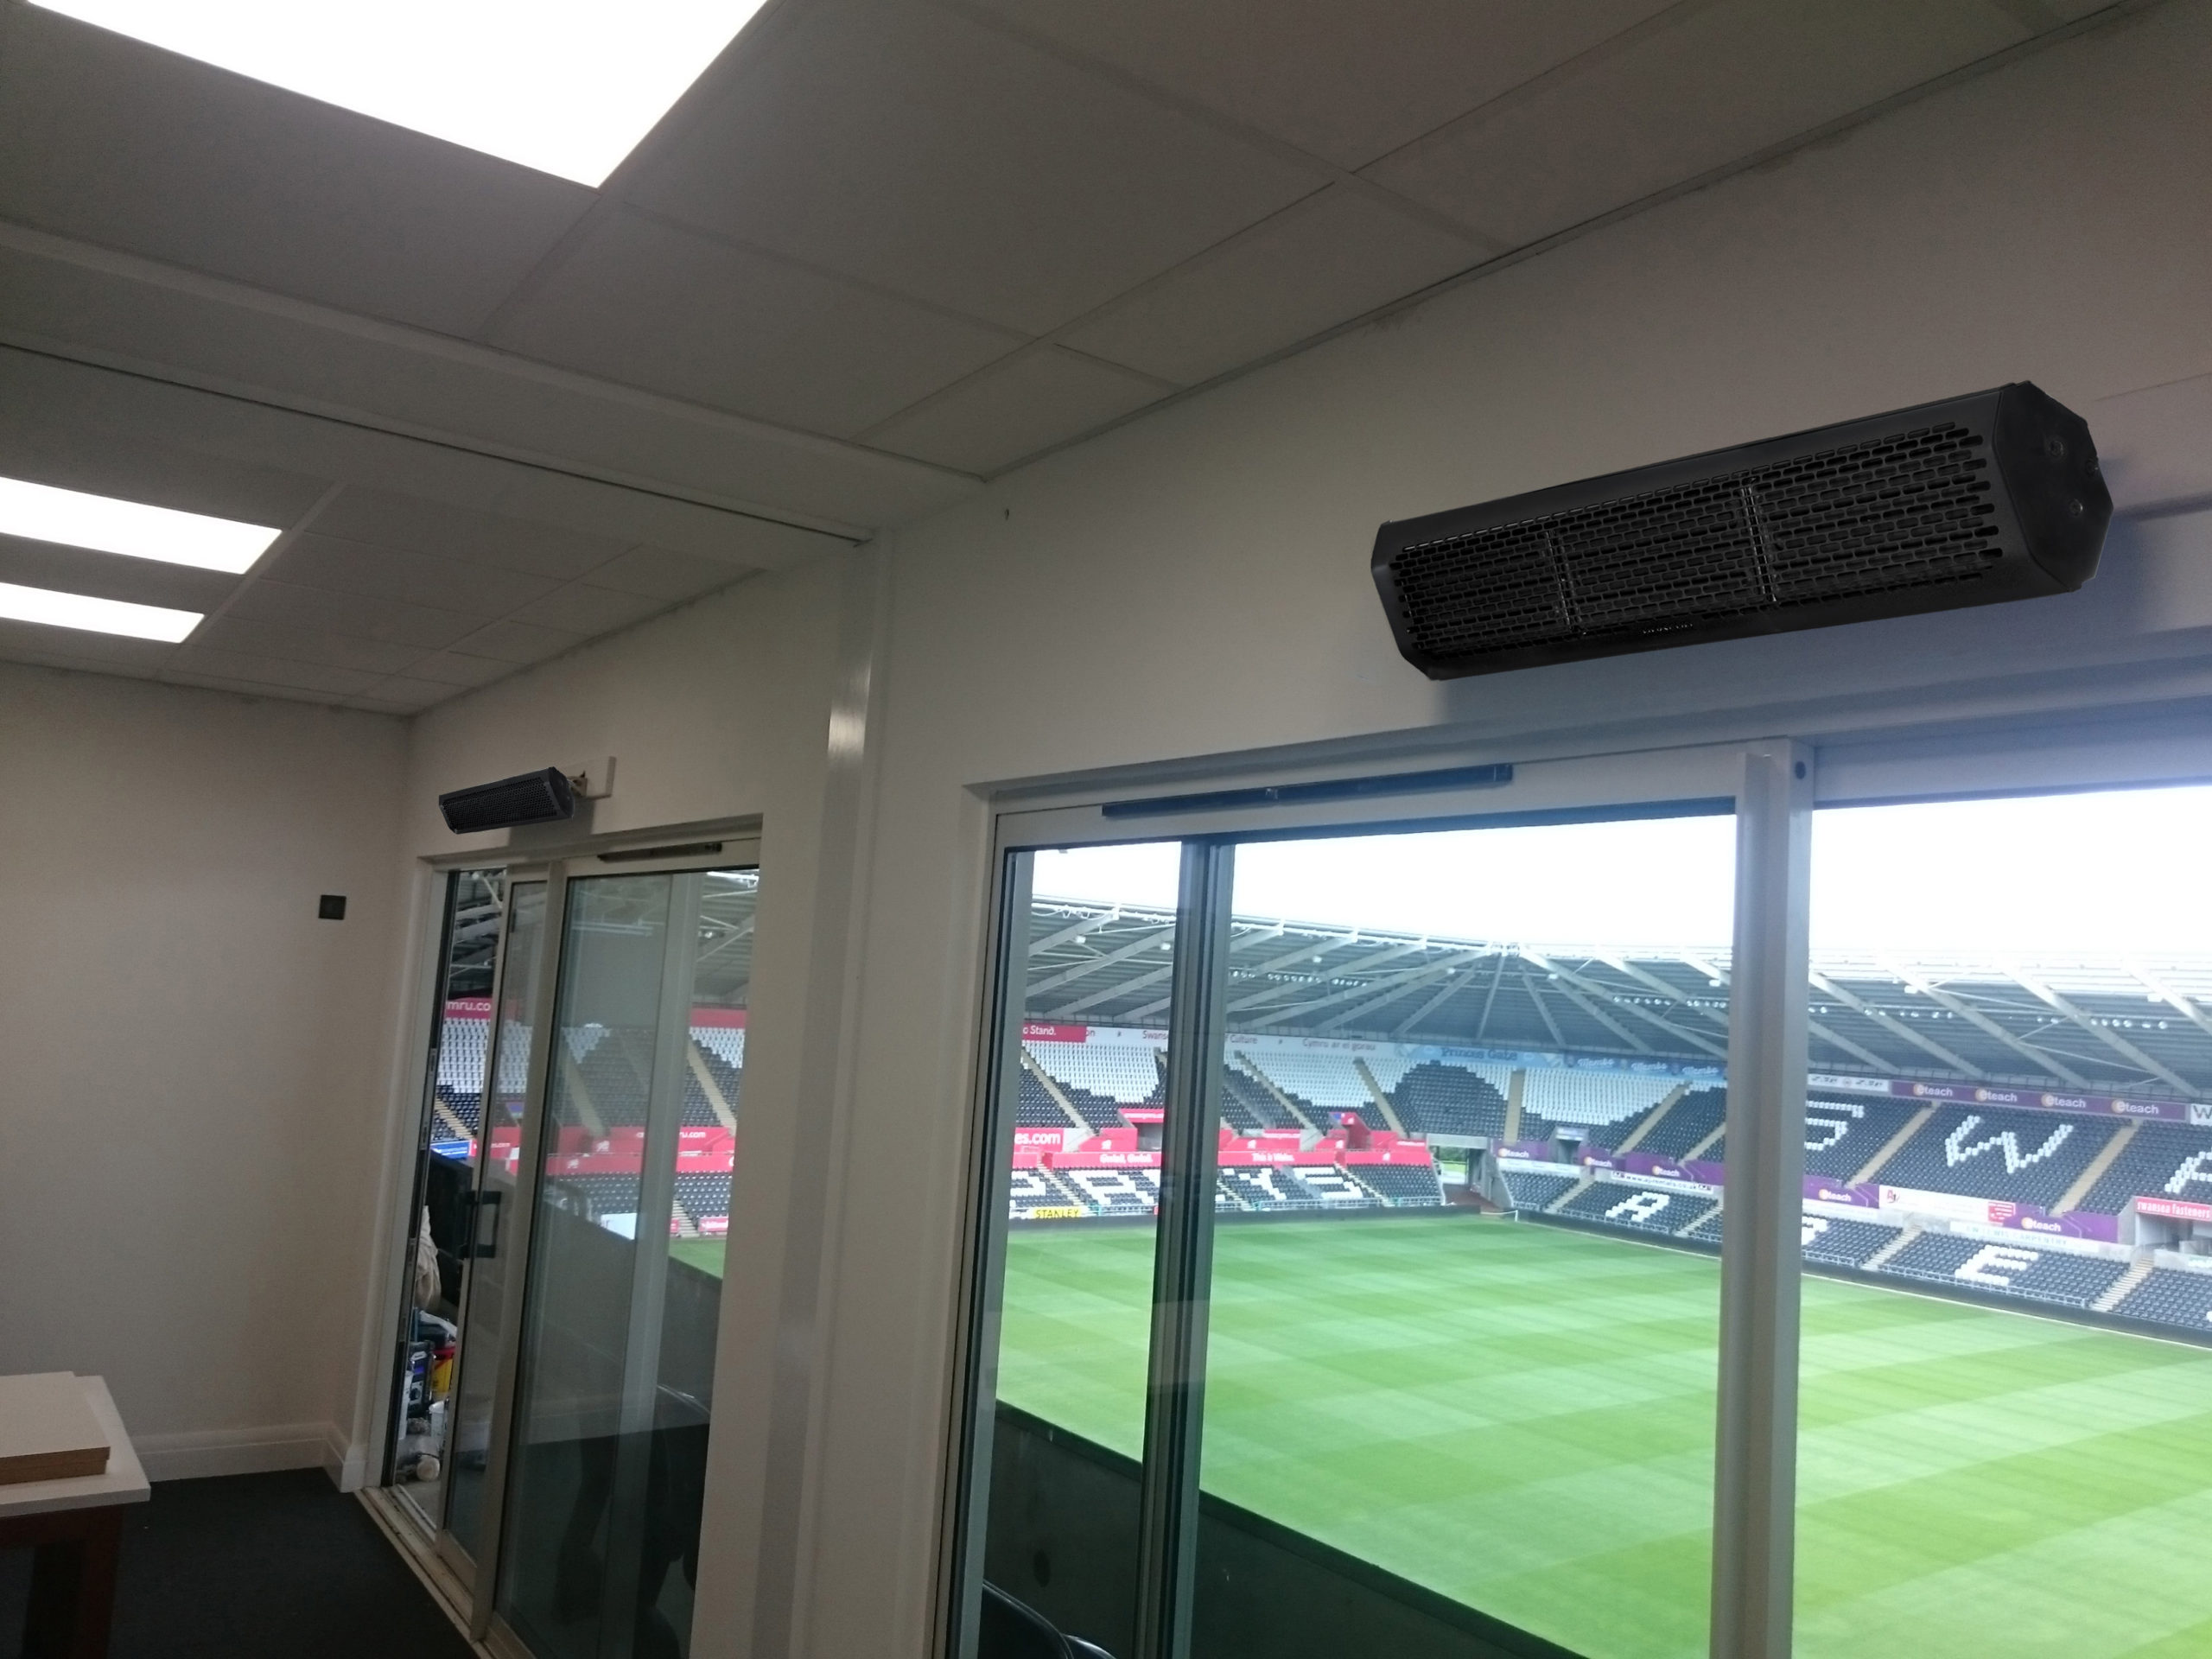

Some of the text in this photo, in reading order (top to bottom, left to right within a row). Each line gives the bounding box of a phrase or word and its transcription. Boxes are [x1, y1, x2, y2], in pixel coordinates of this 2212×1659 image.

[1142, 1030, 1168, 1039] Swans
[1487, 1048, 1518, 1061] Gate
[1981, 1088, 2018, 1103] eteach
[2045, 1094, 2087, 1109] eteach
[2117, 1100, 2159, 1115] eteach
[1014, 1133, 1061, 1145] es.com
[1036, 1209, 1079, 1219] STANLEY
[2137, 1201, 2210, 1219] swansea fasteners
[2024, 1217, 2062, 1232] eteach
